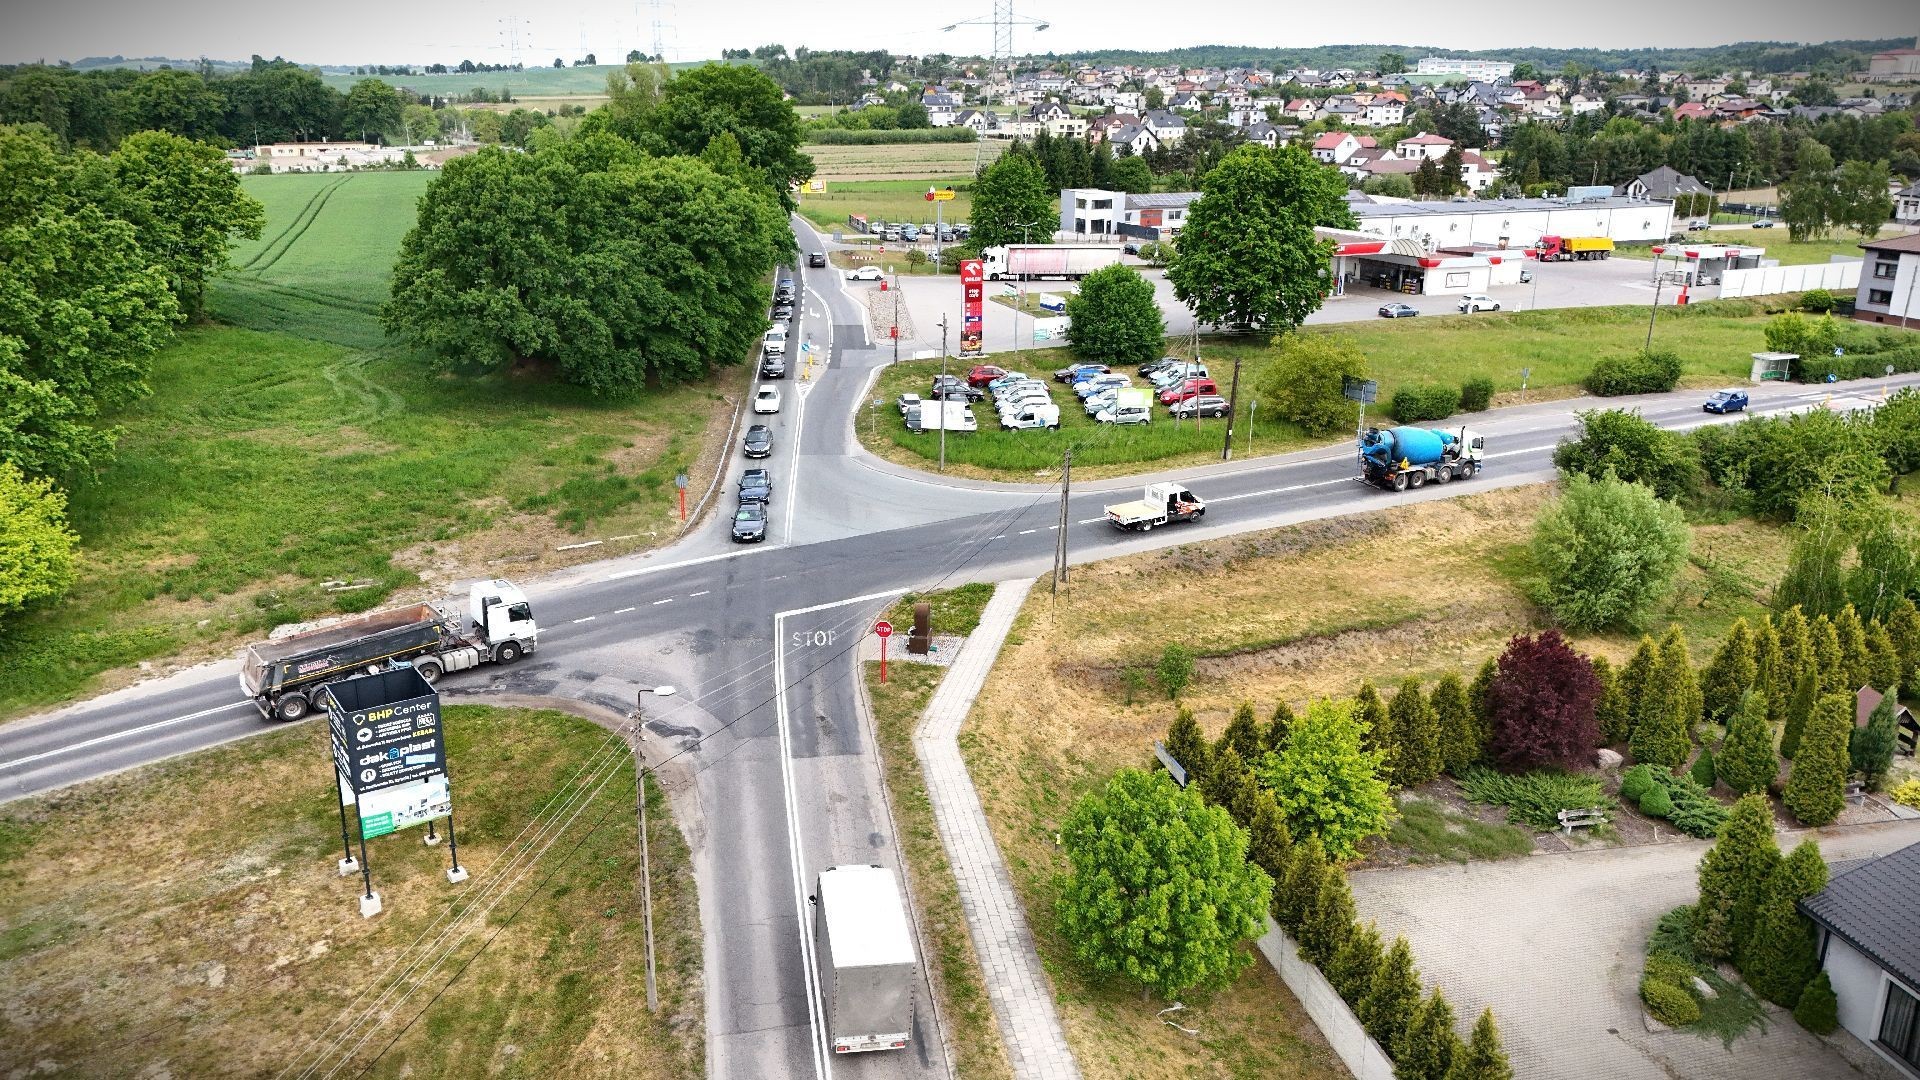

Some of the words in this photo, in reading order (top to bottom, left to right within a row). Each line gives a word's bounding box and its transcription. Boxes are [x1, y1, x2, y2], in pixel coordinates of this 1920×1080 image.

[876, 625, 891, 633] STOP
[792, 630, 837, 647] STOP
[368, 708, 393, 722] BHP
[393, 702, 432, 716] Center
